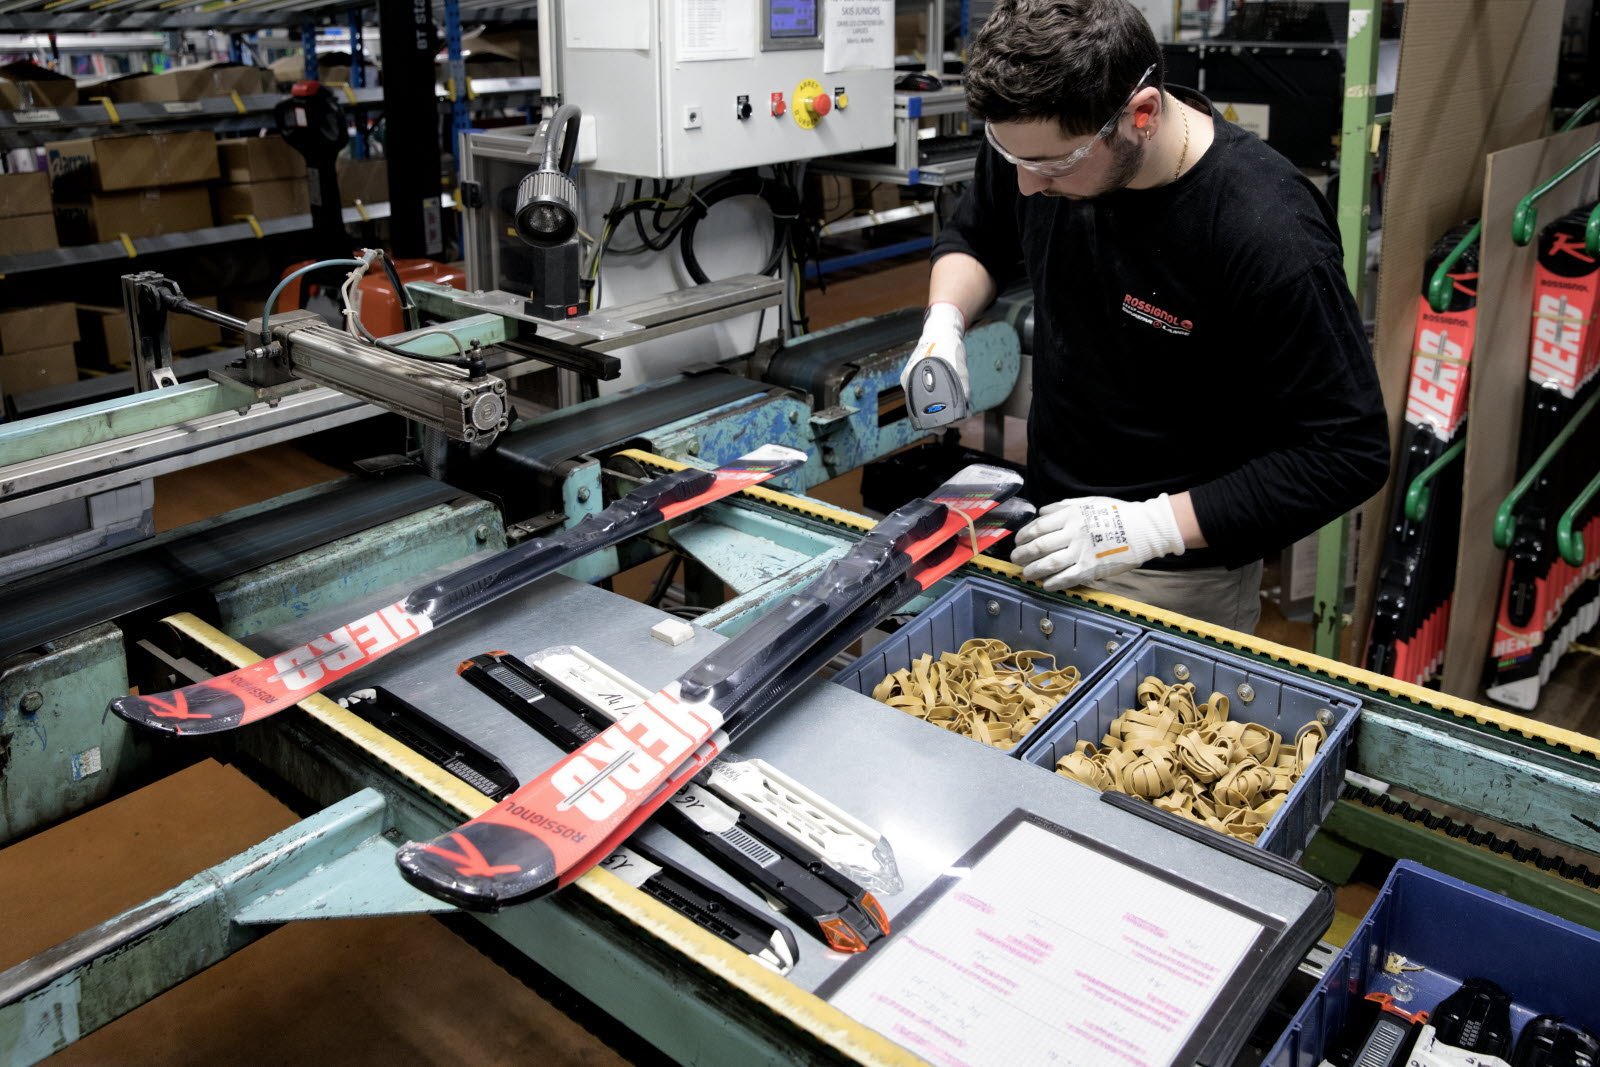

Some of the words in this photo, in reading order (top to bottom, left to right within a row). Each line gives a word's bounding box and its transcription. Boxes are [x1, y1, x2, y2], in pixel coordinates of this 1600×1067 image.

[841, 6, 854, 15] SKIS
[855, 6, 880, 16] JUNIORS
[1540, 279, 1589, 293] ROSSIGNOL
[1123, 293, 1180, 326] ROSSIGNOL
[1422, 313, 1471, 328] ROSSIGNOL
[1528, 293, 1584, 400] HERO
[1405, 328, 1463, 443] HERO
[273, 597, 434, 691] HERO
[550, 688, 727, 823] HERO
[503, 800, 588, 843] ROSSIGNOL
